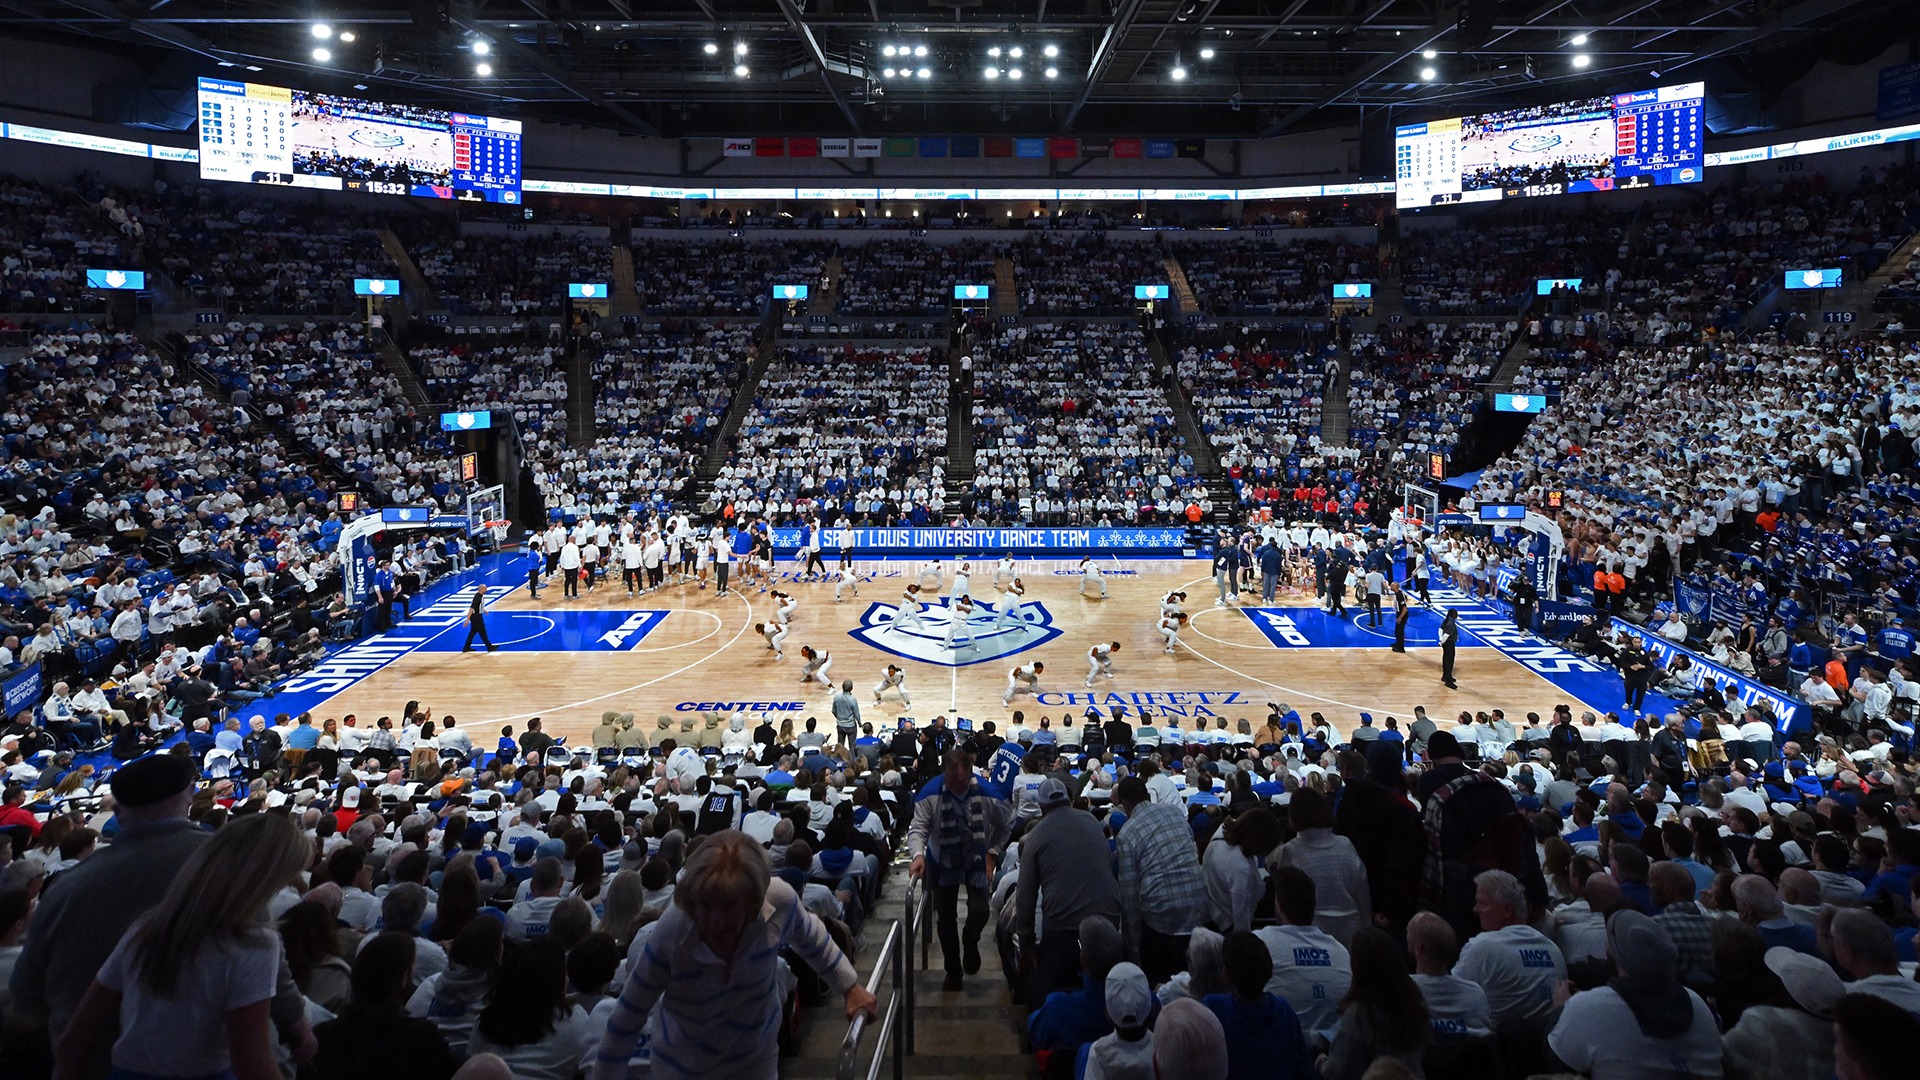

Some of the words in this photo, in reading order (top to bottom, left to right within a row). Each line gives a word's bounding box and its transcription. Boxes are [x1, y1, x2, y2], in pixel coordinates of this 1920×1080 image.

[220, 84, 244, 93] LIGHT
[1631, 92, 1656, 102] bank
[466, 116, 486, 125] bank
[1827, 133, 1882, 150] BILLIKENS
[159, 151, 197, 160] BILLIKENS
[1729, 152, 1764, 162] BILLIKENS
[266, 173, 280, 184] 11
[1630, 176, 1638, 184] 3
[366, 181, 406, 195] 15:32
[1523, 183, 1562, 197] 15:32
[1442, 193, 1452, 203] 11
[200, 314, 220, 322] 111
[1827, 312, 1852, 322] 119
[343, 501, 353, 509] 30
[870, 529, 909, 547] LOUIS
[914, 529, 995, 547] UNIVERSITY
[1000, 530, 1045, 547] DANCE
[1051, 530, 1090, 547] TEAM
[356, 558, 366, 592] FUSZ
[596, 612, 653, 648] A10
[1256, 610, 1310, 645] A10
[11, 684, 37, 706] NETWORK
[1037, 692, 1250, 705] CHAIFETZ
[675, 702, 806, 711] CENTENE
[1084, 705, 1218, 717] ARENA
[997, 761, 1010, 783] 3
[1293, 948, 1329, 959] IMO'S
[1519, 950, 1551, 960] IMO'S
